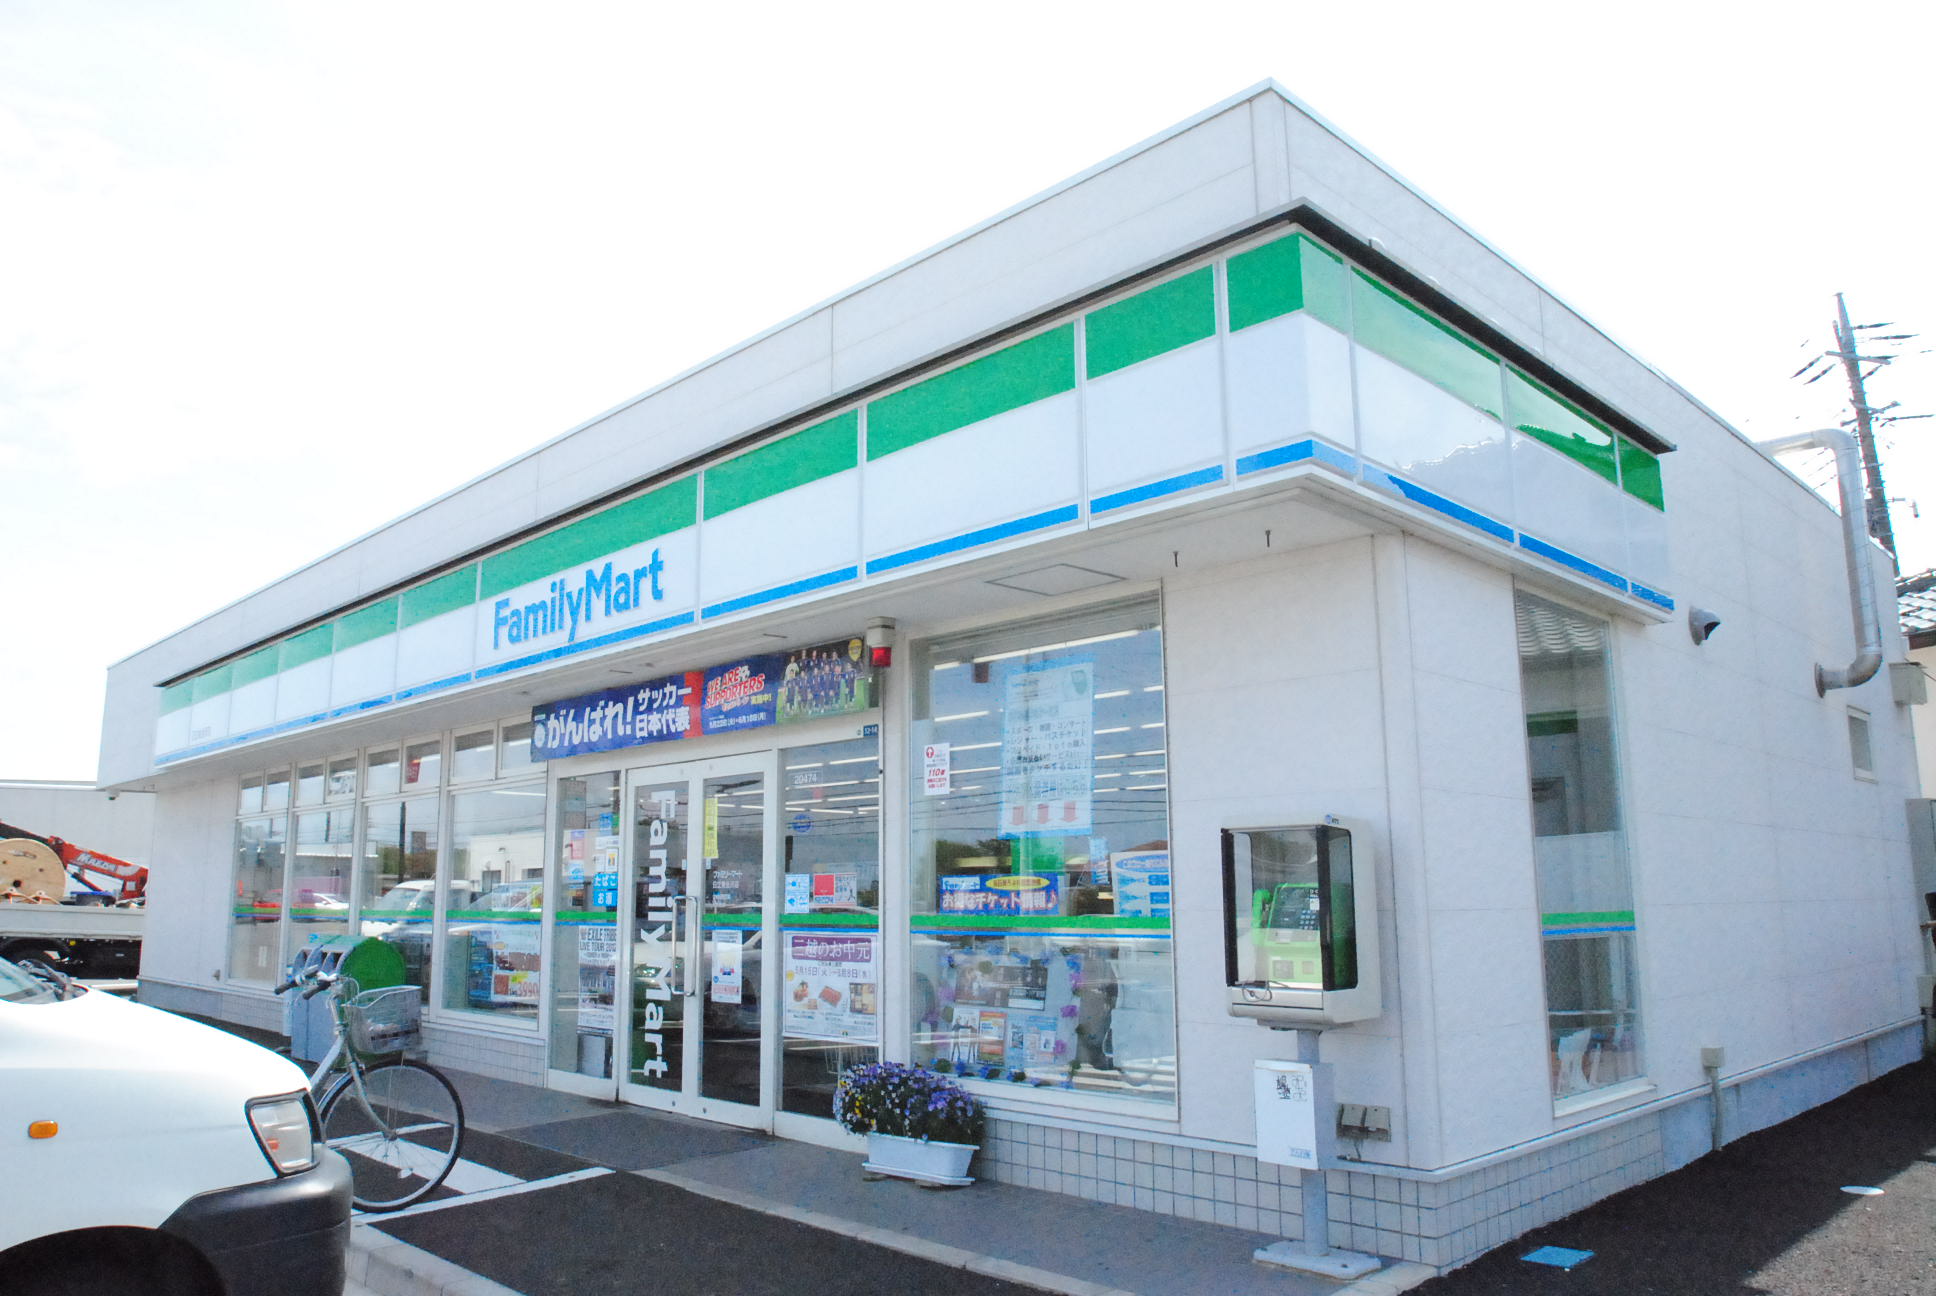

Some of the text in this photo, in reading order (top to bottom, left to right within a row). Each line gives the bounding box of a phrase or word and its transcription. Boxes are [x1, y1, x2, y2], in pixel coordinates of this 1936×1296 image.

[493, 548, 664, 650] FamilyMart
[705, 674, 765, 709] SUPPORTERS
[707, 667, 740, 693] WE ARE
[637, 683, 692, 712] サッカー
[636, 706, 691, 739] 日本代表
[794, 773, 817, 784] 20474
[595, 875, 617, 887] たばこ
[580, 941, 591, 951] LIVE
[592, 942, 605, 952] TOUR
[587, 928, 603, 941] EXILE
